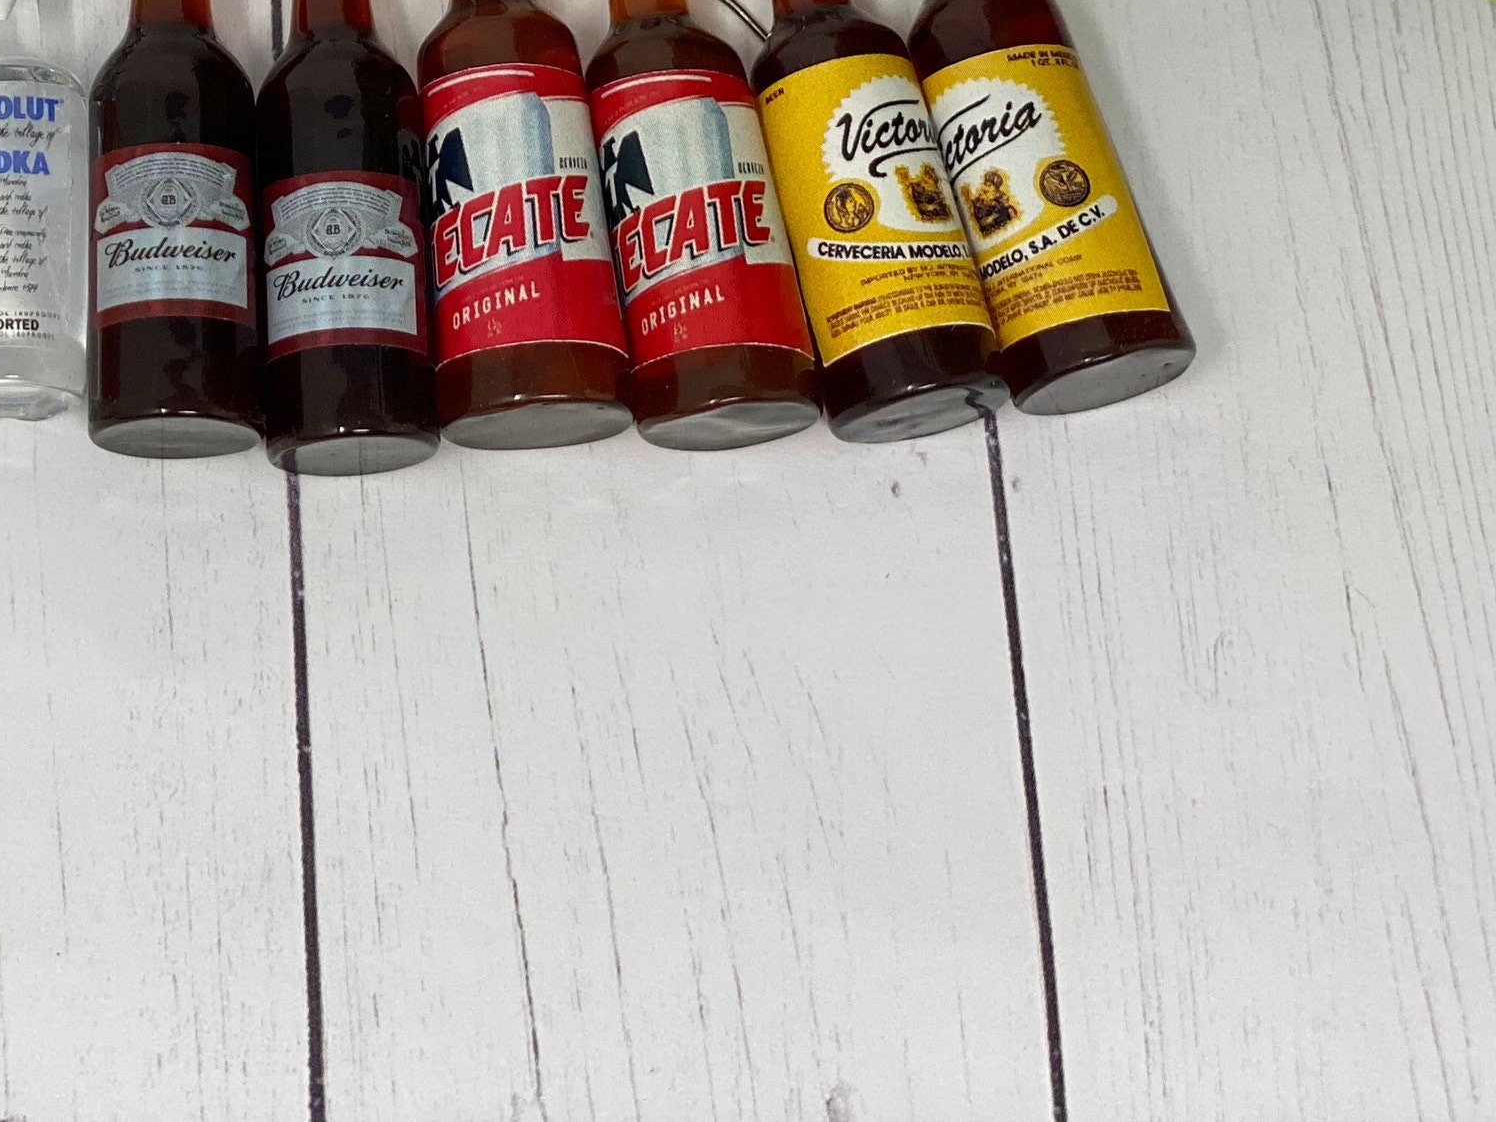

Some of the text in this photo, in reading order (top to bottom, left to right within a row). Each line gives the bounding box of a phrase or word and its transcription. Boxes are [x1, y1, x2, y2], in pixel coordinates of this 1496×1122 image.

[1006, 50, 1036, 62] MADE
[433, 175, 590, 290] ECATE
[612, 180, 770, 294] ECATE
[818, 241, 965, 260] CERVECERIA MODELO,
[1028, 235, 1057, 255] S.A.
[1057, 219, 1080, 239] DE
[1078, 205, 1106, 228] C.V.
[105, 237, 236, 268] Budweiser
[273, 266, 404, 301] Budweiser
[302, 293, 334, 303] SINCE
[453, 280, 541, 329] ORIGINAL
[641, 284, 725, 335] ORIGINAL
